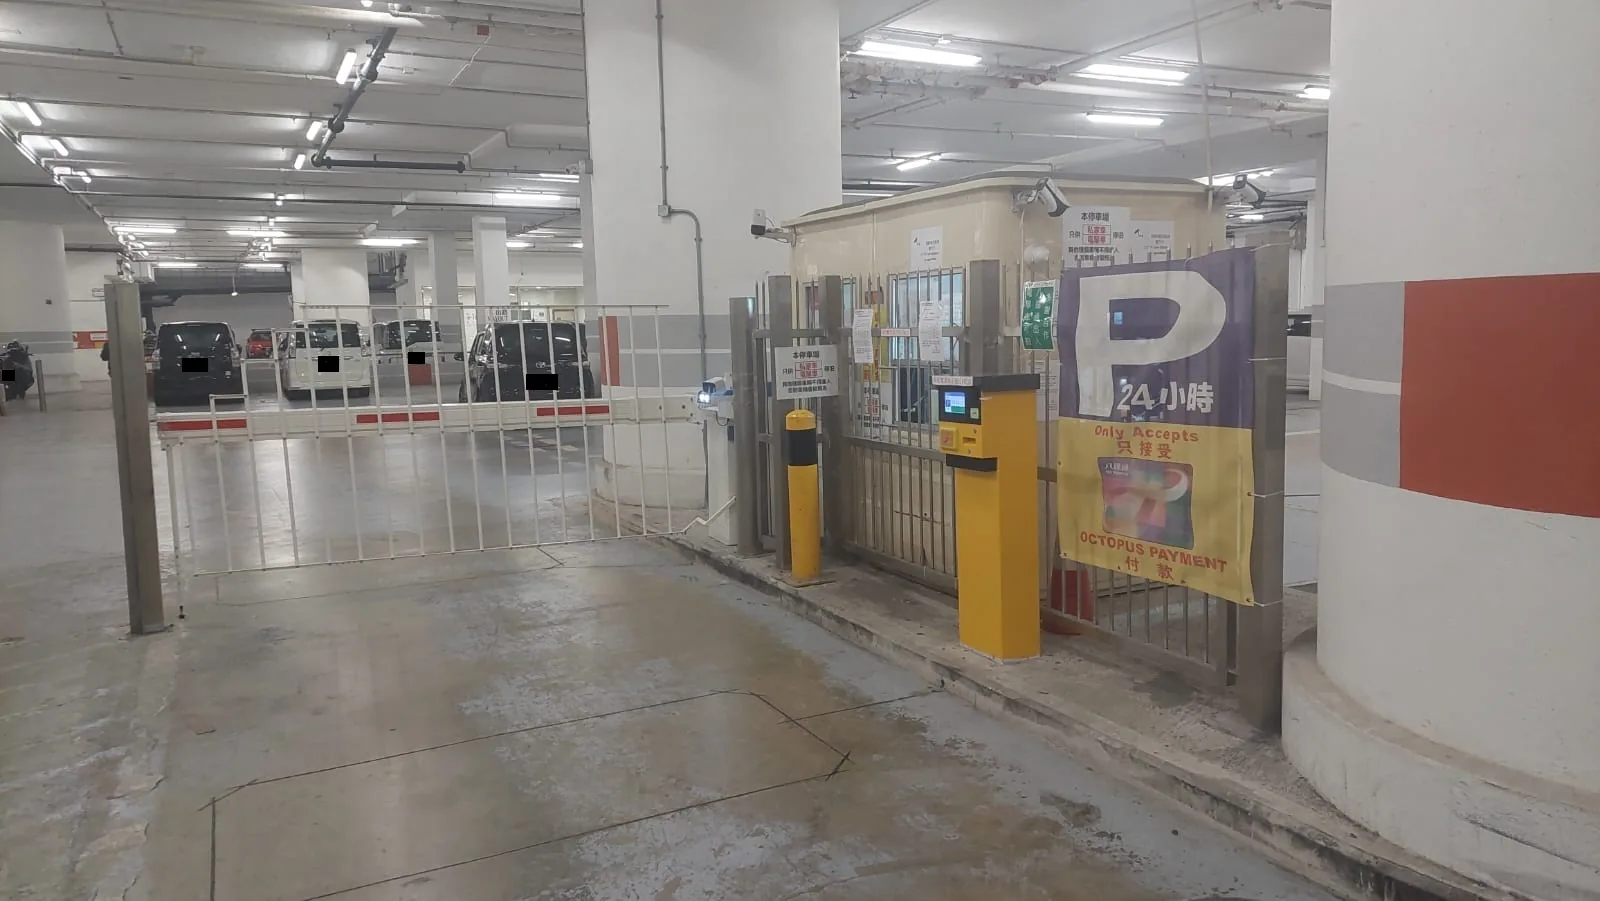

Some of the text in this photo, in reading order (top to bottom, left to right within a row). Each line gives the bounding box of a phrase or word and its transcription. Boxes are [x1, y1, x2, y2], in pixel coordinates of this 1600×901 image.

[1081, 212, 1110, 221] 本停車場
[1075, 270, 1226, 417] P
[1117, 381, 1215, 413] 24小時
[1095, 425, 1200, 443] Only Accepts
[1117, 441, 1172, 459] 只接受
[1080, 531, 1227, 573] OCTOPUS PAYMENT
[1125, 556, 1175, 581] 付款
